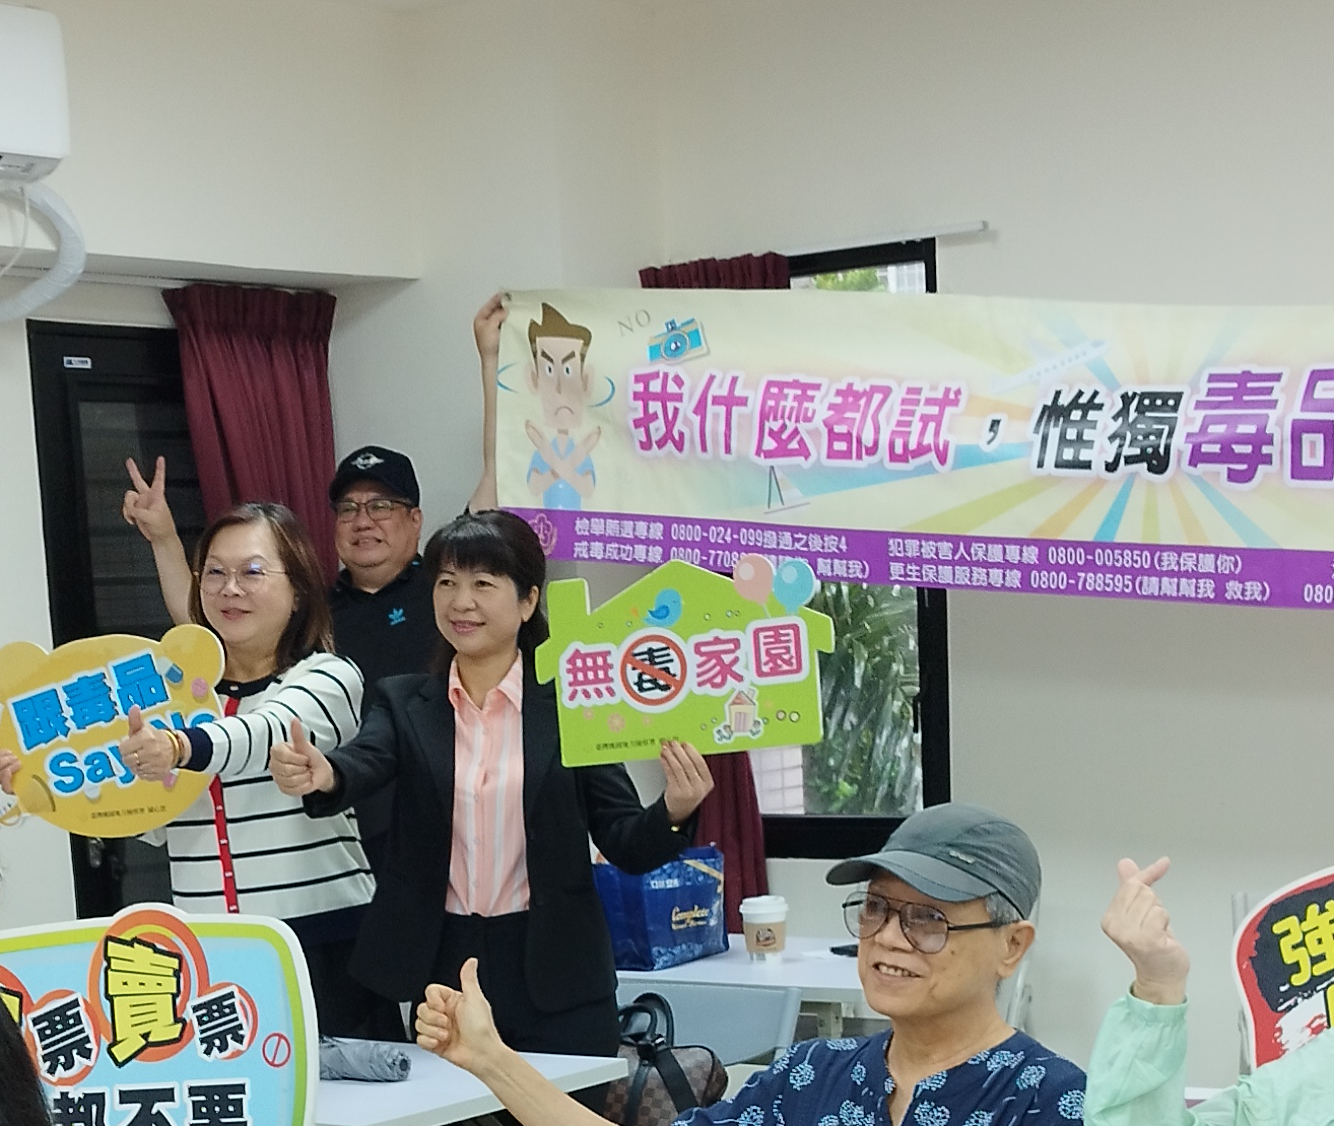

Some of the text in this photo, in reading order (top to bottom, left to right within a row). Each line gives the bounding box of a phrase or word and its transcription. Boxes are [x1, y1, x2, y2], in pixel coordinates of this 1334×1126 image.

[617, 309, 652, 337] NO
[574, 516, 664, 541] 檢舉賄選專線
[573, 541, 664, 564] 戒毒成功專線
[887, 538, 1243, 575] 犯罪被害人保護專線 0800-005850(我保護你)
[888, 561, 1022, 590] 更生保護服務專線
[565, 623, 804, 702] 無毒家園
[11, 653, 170, 751] 跟毒品
